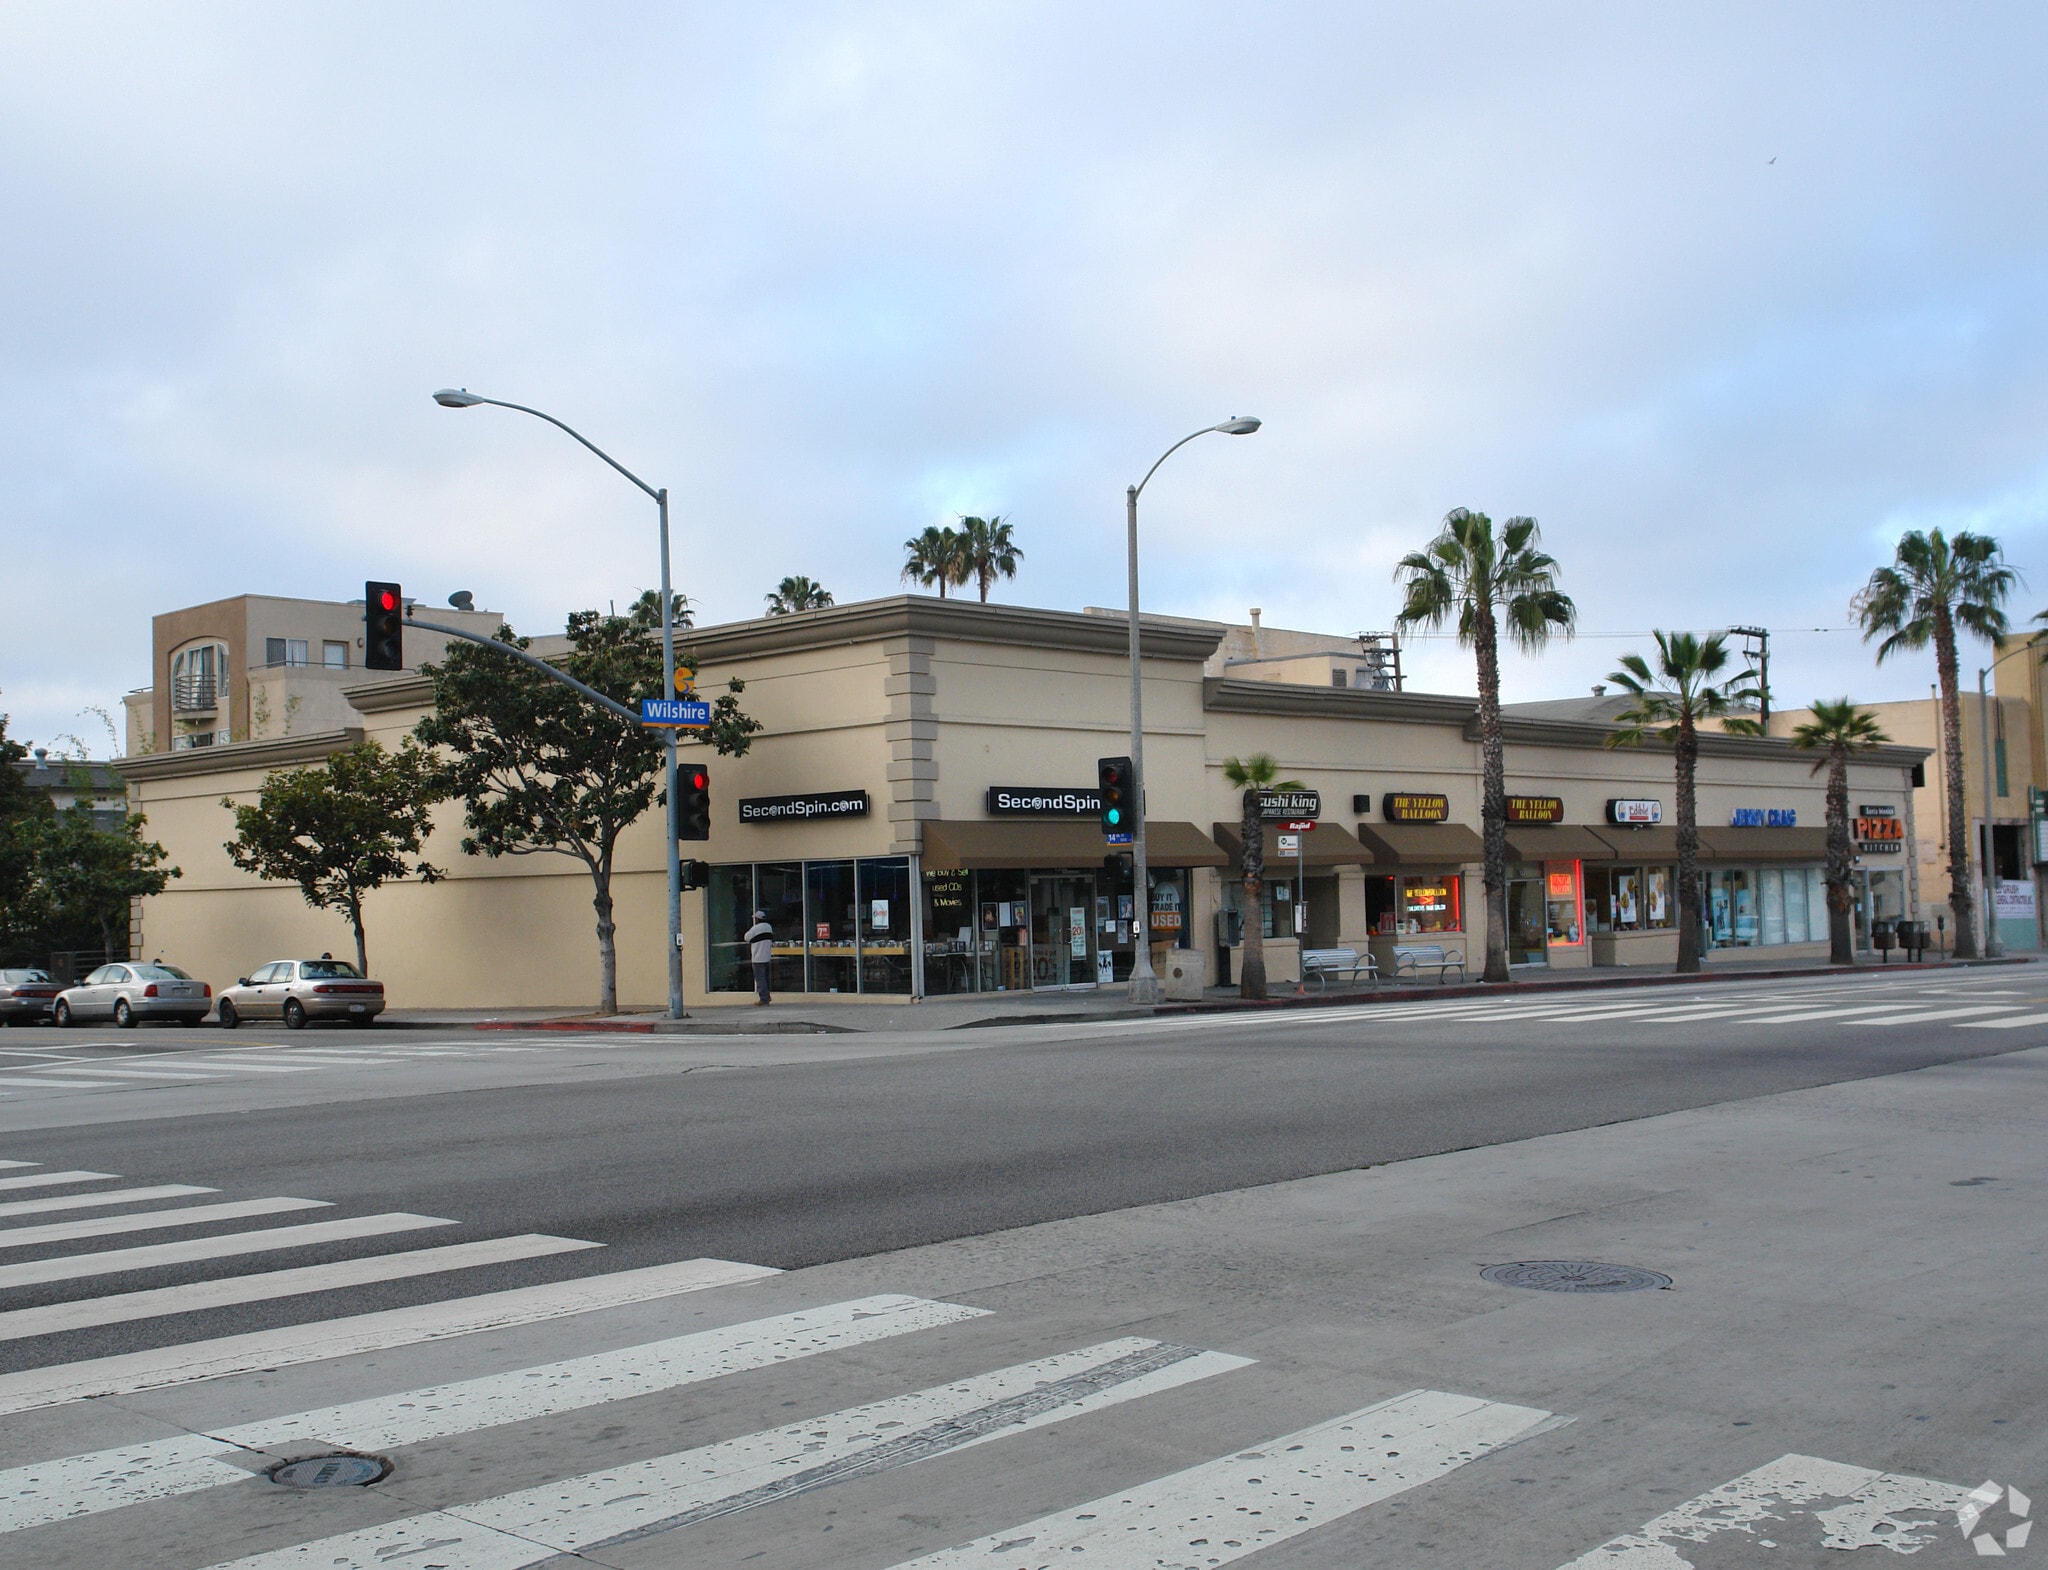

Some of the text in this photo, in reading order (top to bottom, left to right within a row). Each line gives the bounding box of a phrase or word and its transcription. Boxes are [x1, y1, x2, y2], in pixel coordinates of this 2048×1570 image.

[647, 702, 706, 719] Wilshire
[742, 799, 863, 817] SecondSpin.com
[1291, 795, 1317, 811] king
[1395, 797, 1445, 808] THE YELLOW
[1511, 799, 1557, 809] THE YELLOW
[1401, 808, 1442, 819] BALLOON
[1519, 809, 1552, 819] BALLOON
[1629, 803, 1649, 816] Edible
[1732, 808, 1797, 827] JENNY CRAIG
[1289, 822, 1311, 830] Rapid
[1857, 817, 1904, 839] PIZZA
[1864, 844, 1900, 852] KITCHEN
[1166, 893, 1173, 901] IT
[1151, 914, 1182, 928] USED
